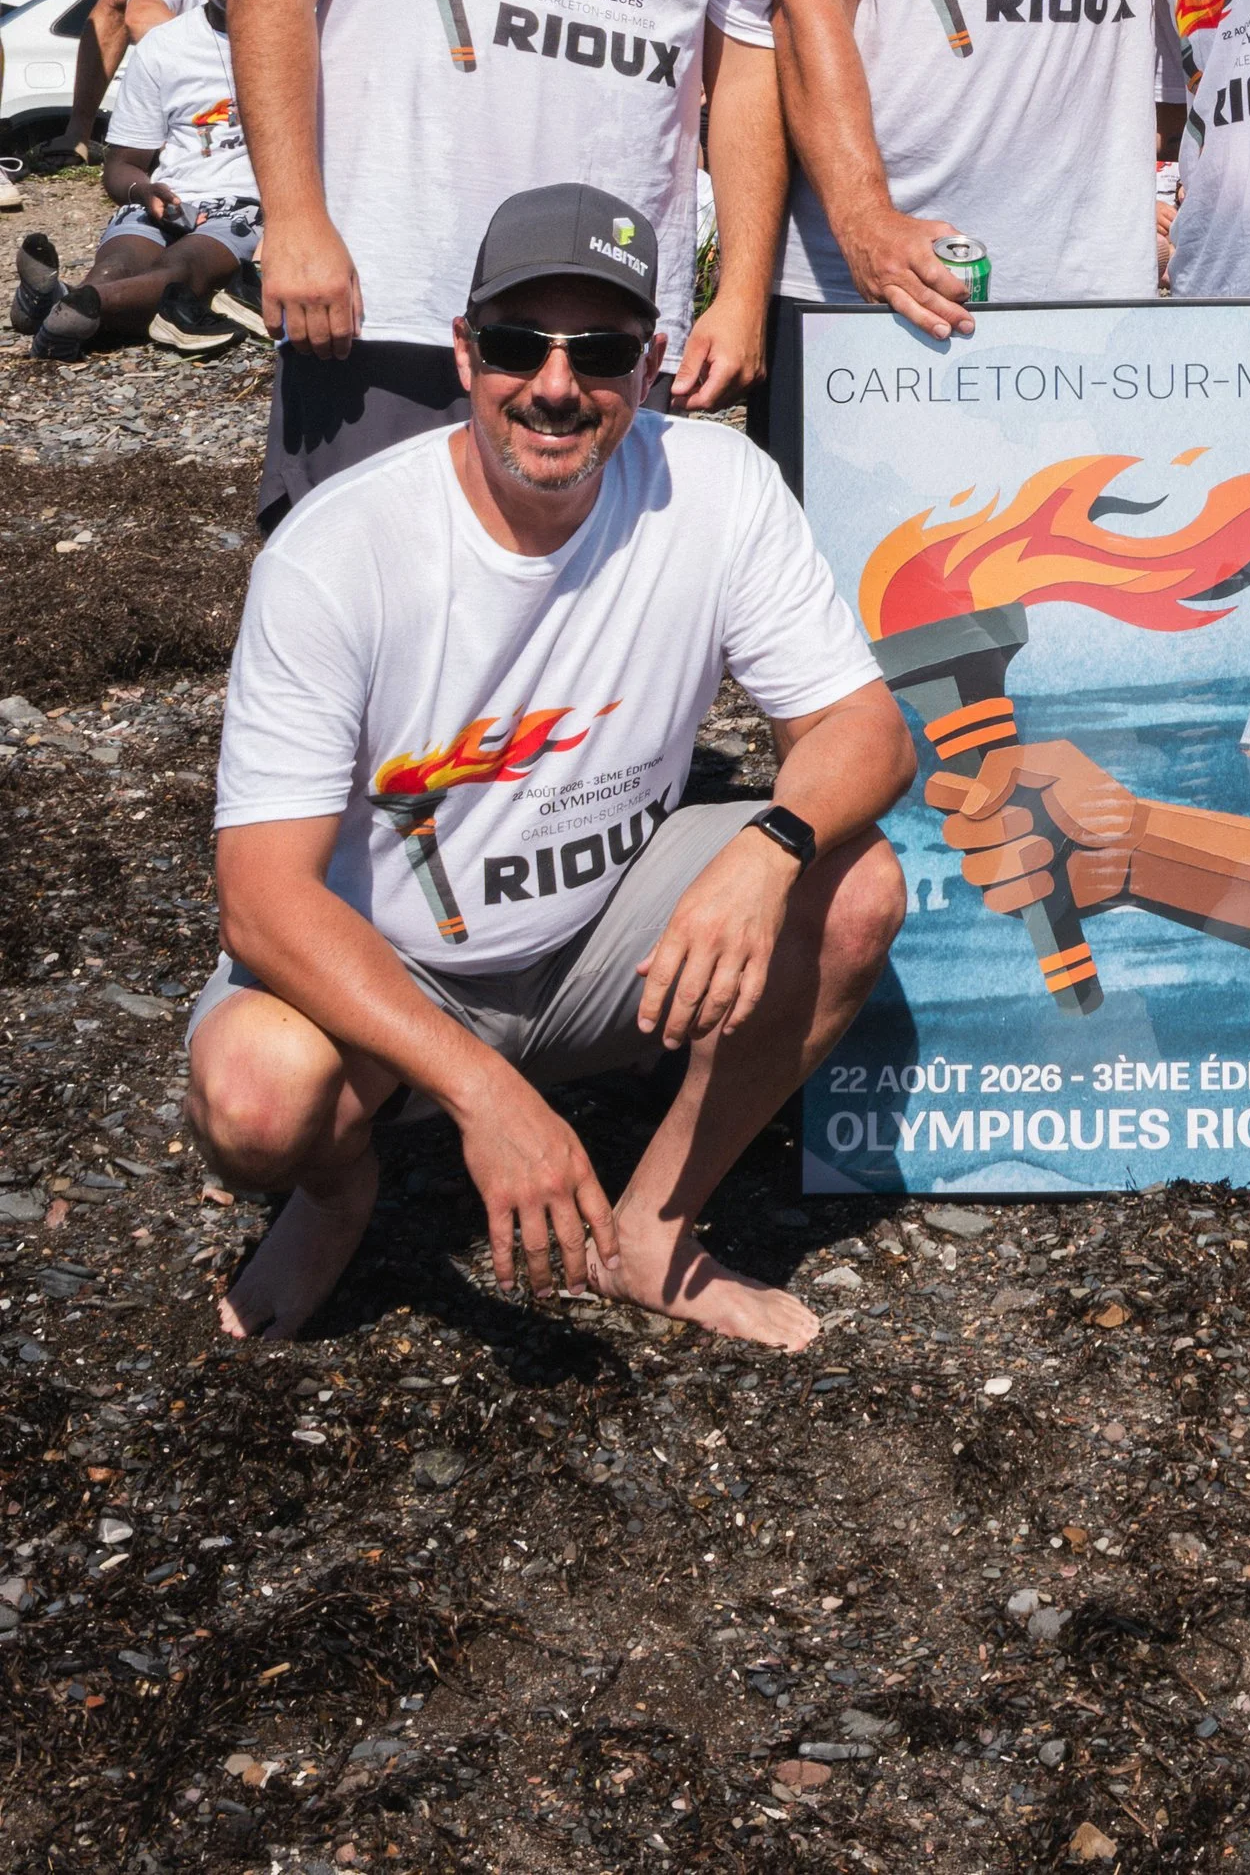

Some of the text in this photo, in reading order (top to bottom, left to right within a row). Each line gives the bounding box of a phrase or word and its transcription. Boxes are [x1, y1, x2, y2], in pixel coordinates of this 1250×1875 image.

[493, 1, 681, 89] RIOUX
[1222, 31, 1233, 40] 22
[589, 236, 648, 277] HABITAT
[512, 791, 524, 802] 22
[526, 785, 557, 799] AOÛT
[560, 780, 584, 796] 2026
[593, 770, 623, 786] 3ÈME
[625, 754, 664, 777] ÉDITION
[539, 776, 641, 816] OLYMPIQUES
[521, 788, 651, 842] CARLETON-SUR-MER
[829, 1065, 867, 1094] 22
[875, 1056, 973, 1094] AOÛT
[980, 1064, 1063, 1093] 2026
[1092, 1054, 1191, 1092] 3ÈME
[826, 1107, 1171, 1152] OLYMPIQUES
